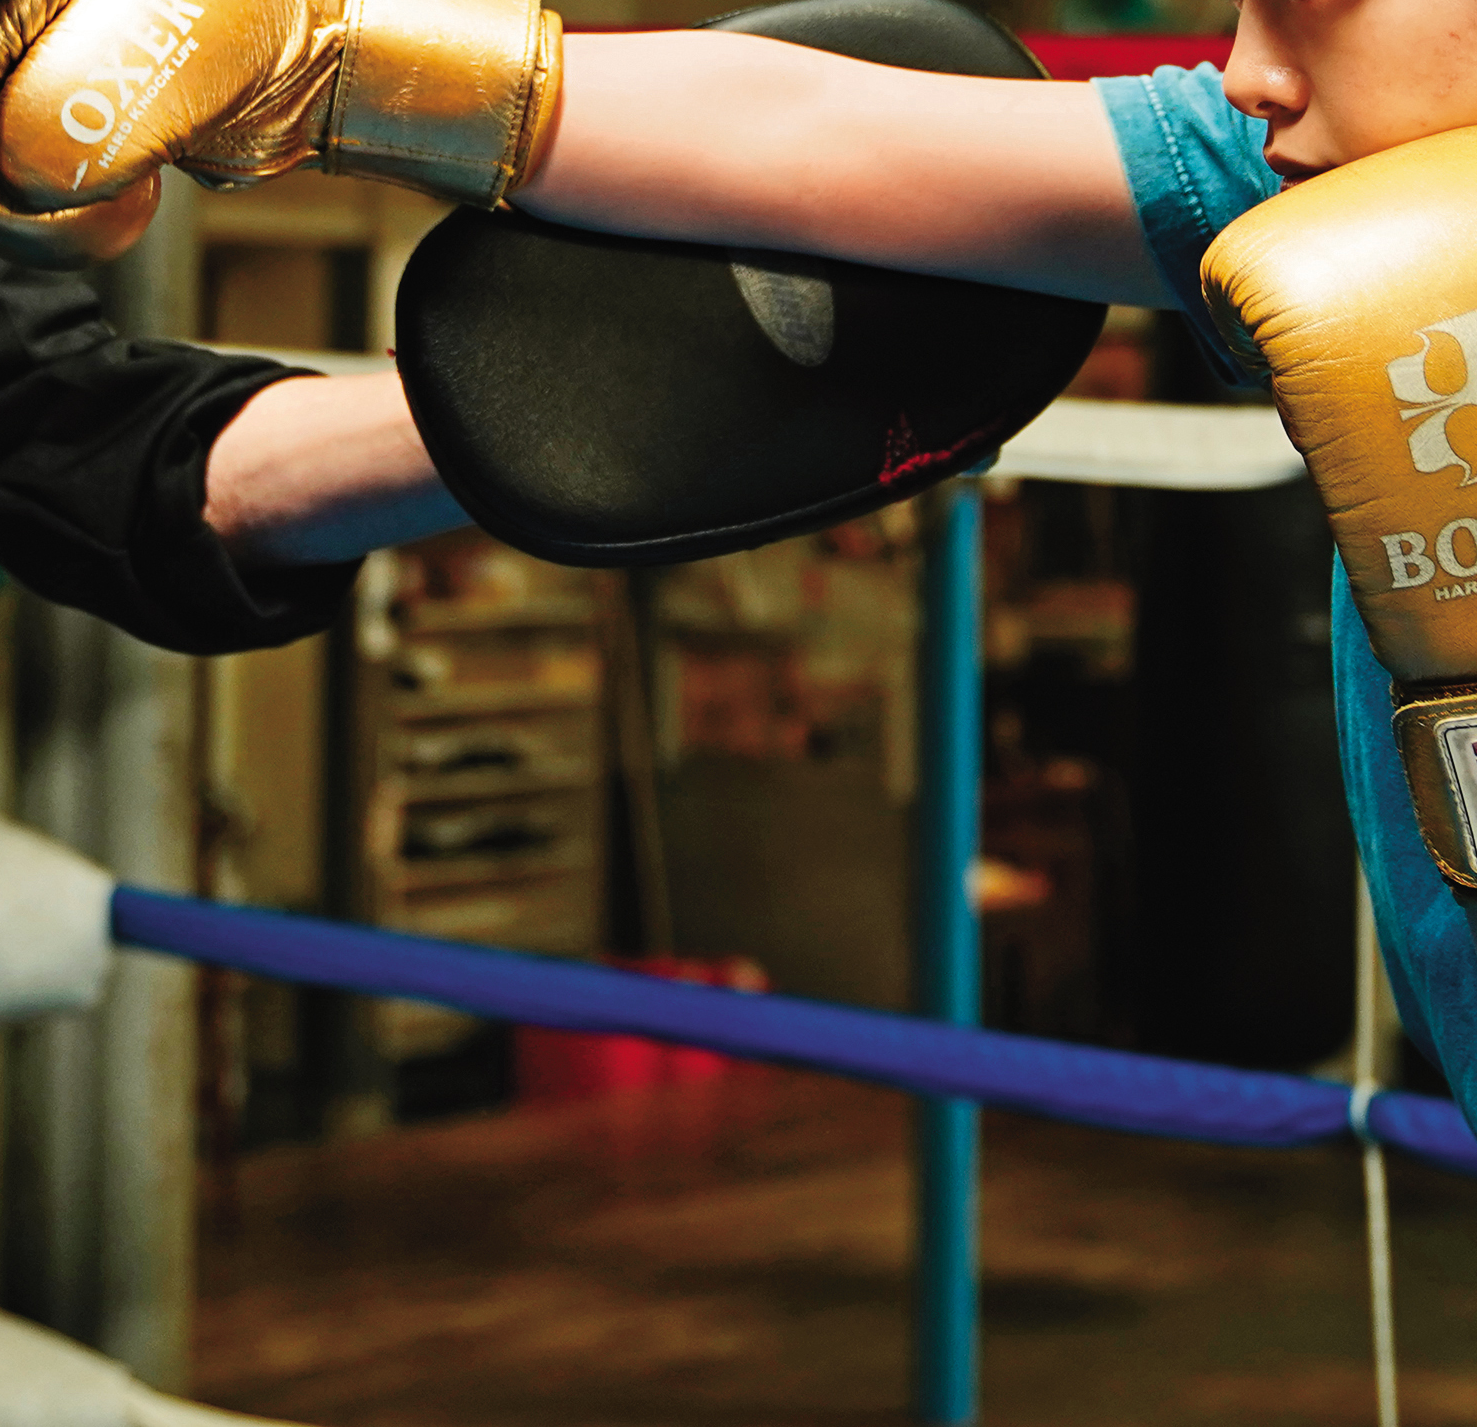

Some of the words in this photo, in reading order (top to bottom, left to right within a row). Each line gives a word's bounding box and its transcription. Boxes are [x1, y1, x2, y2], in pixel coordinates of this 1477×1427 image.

[98, 125, 133, 169] HARD
[128, 64, 175, 121] KNOCK
[172, 37, 199, 68] LIFE
